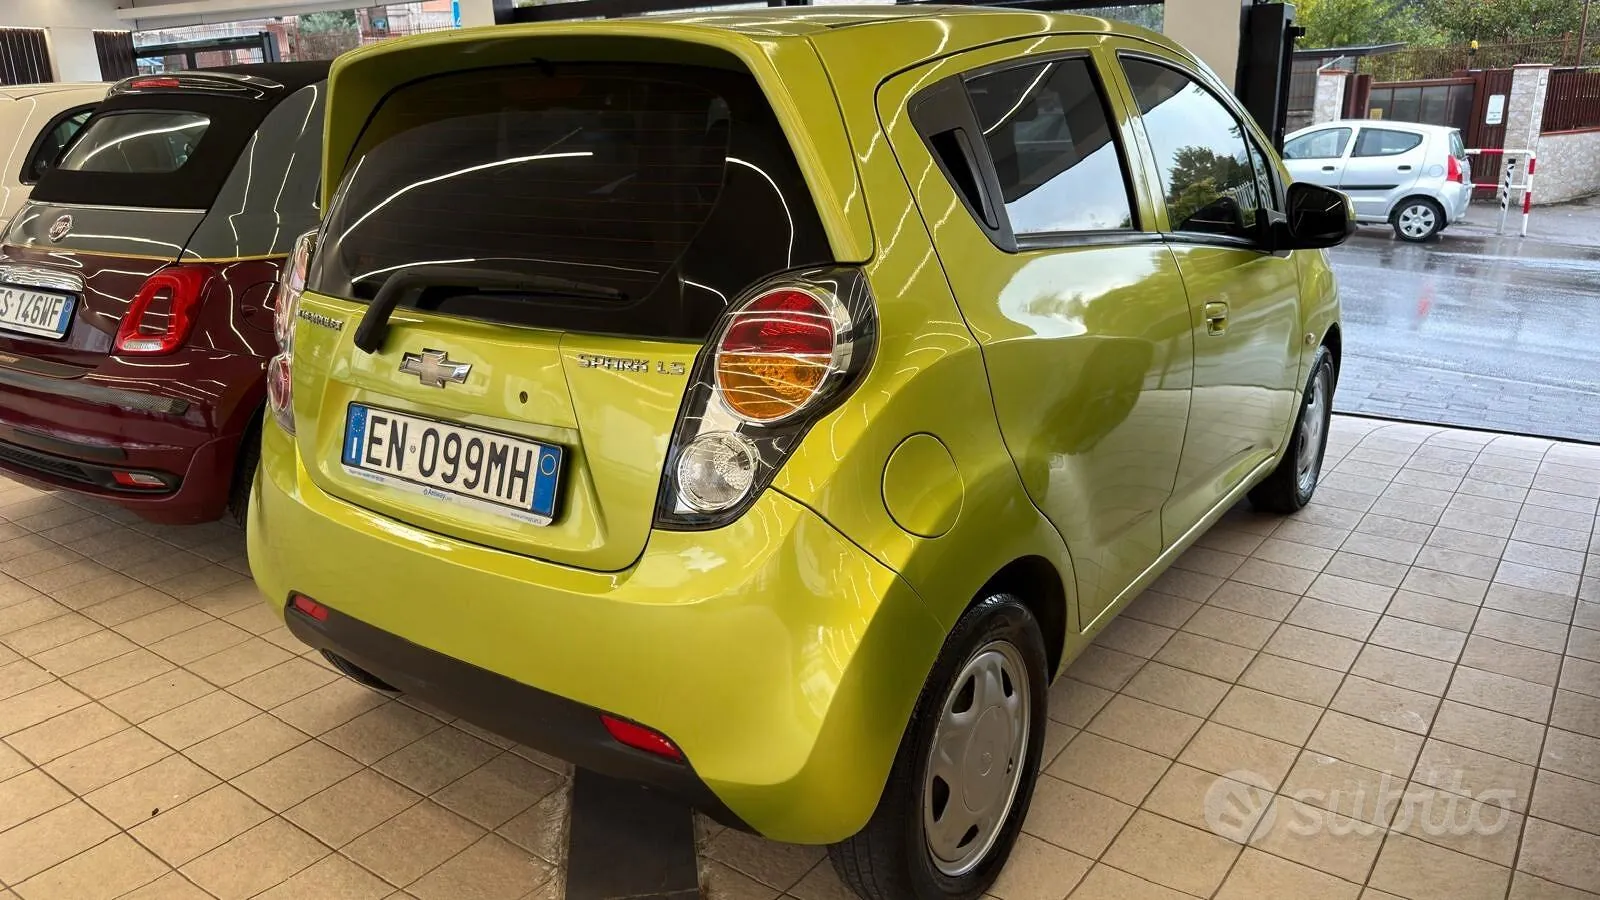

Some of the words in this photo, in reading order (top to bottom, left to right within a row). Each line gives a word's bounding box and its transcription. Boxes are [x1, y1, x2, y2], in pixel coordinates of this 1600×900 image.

[15, 293, 63, 327] 146WF
[577, 353, 650, 373] SPARK
[656, 360, 686, 376] LS
[365, 415, 408, 471] EN
[418, 427, 533, 503] 099MH
